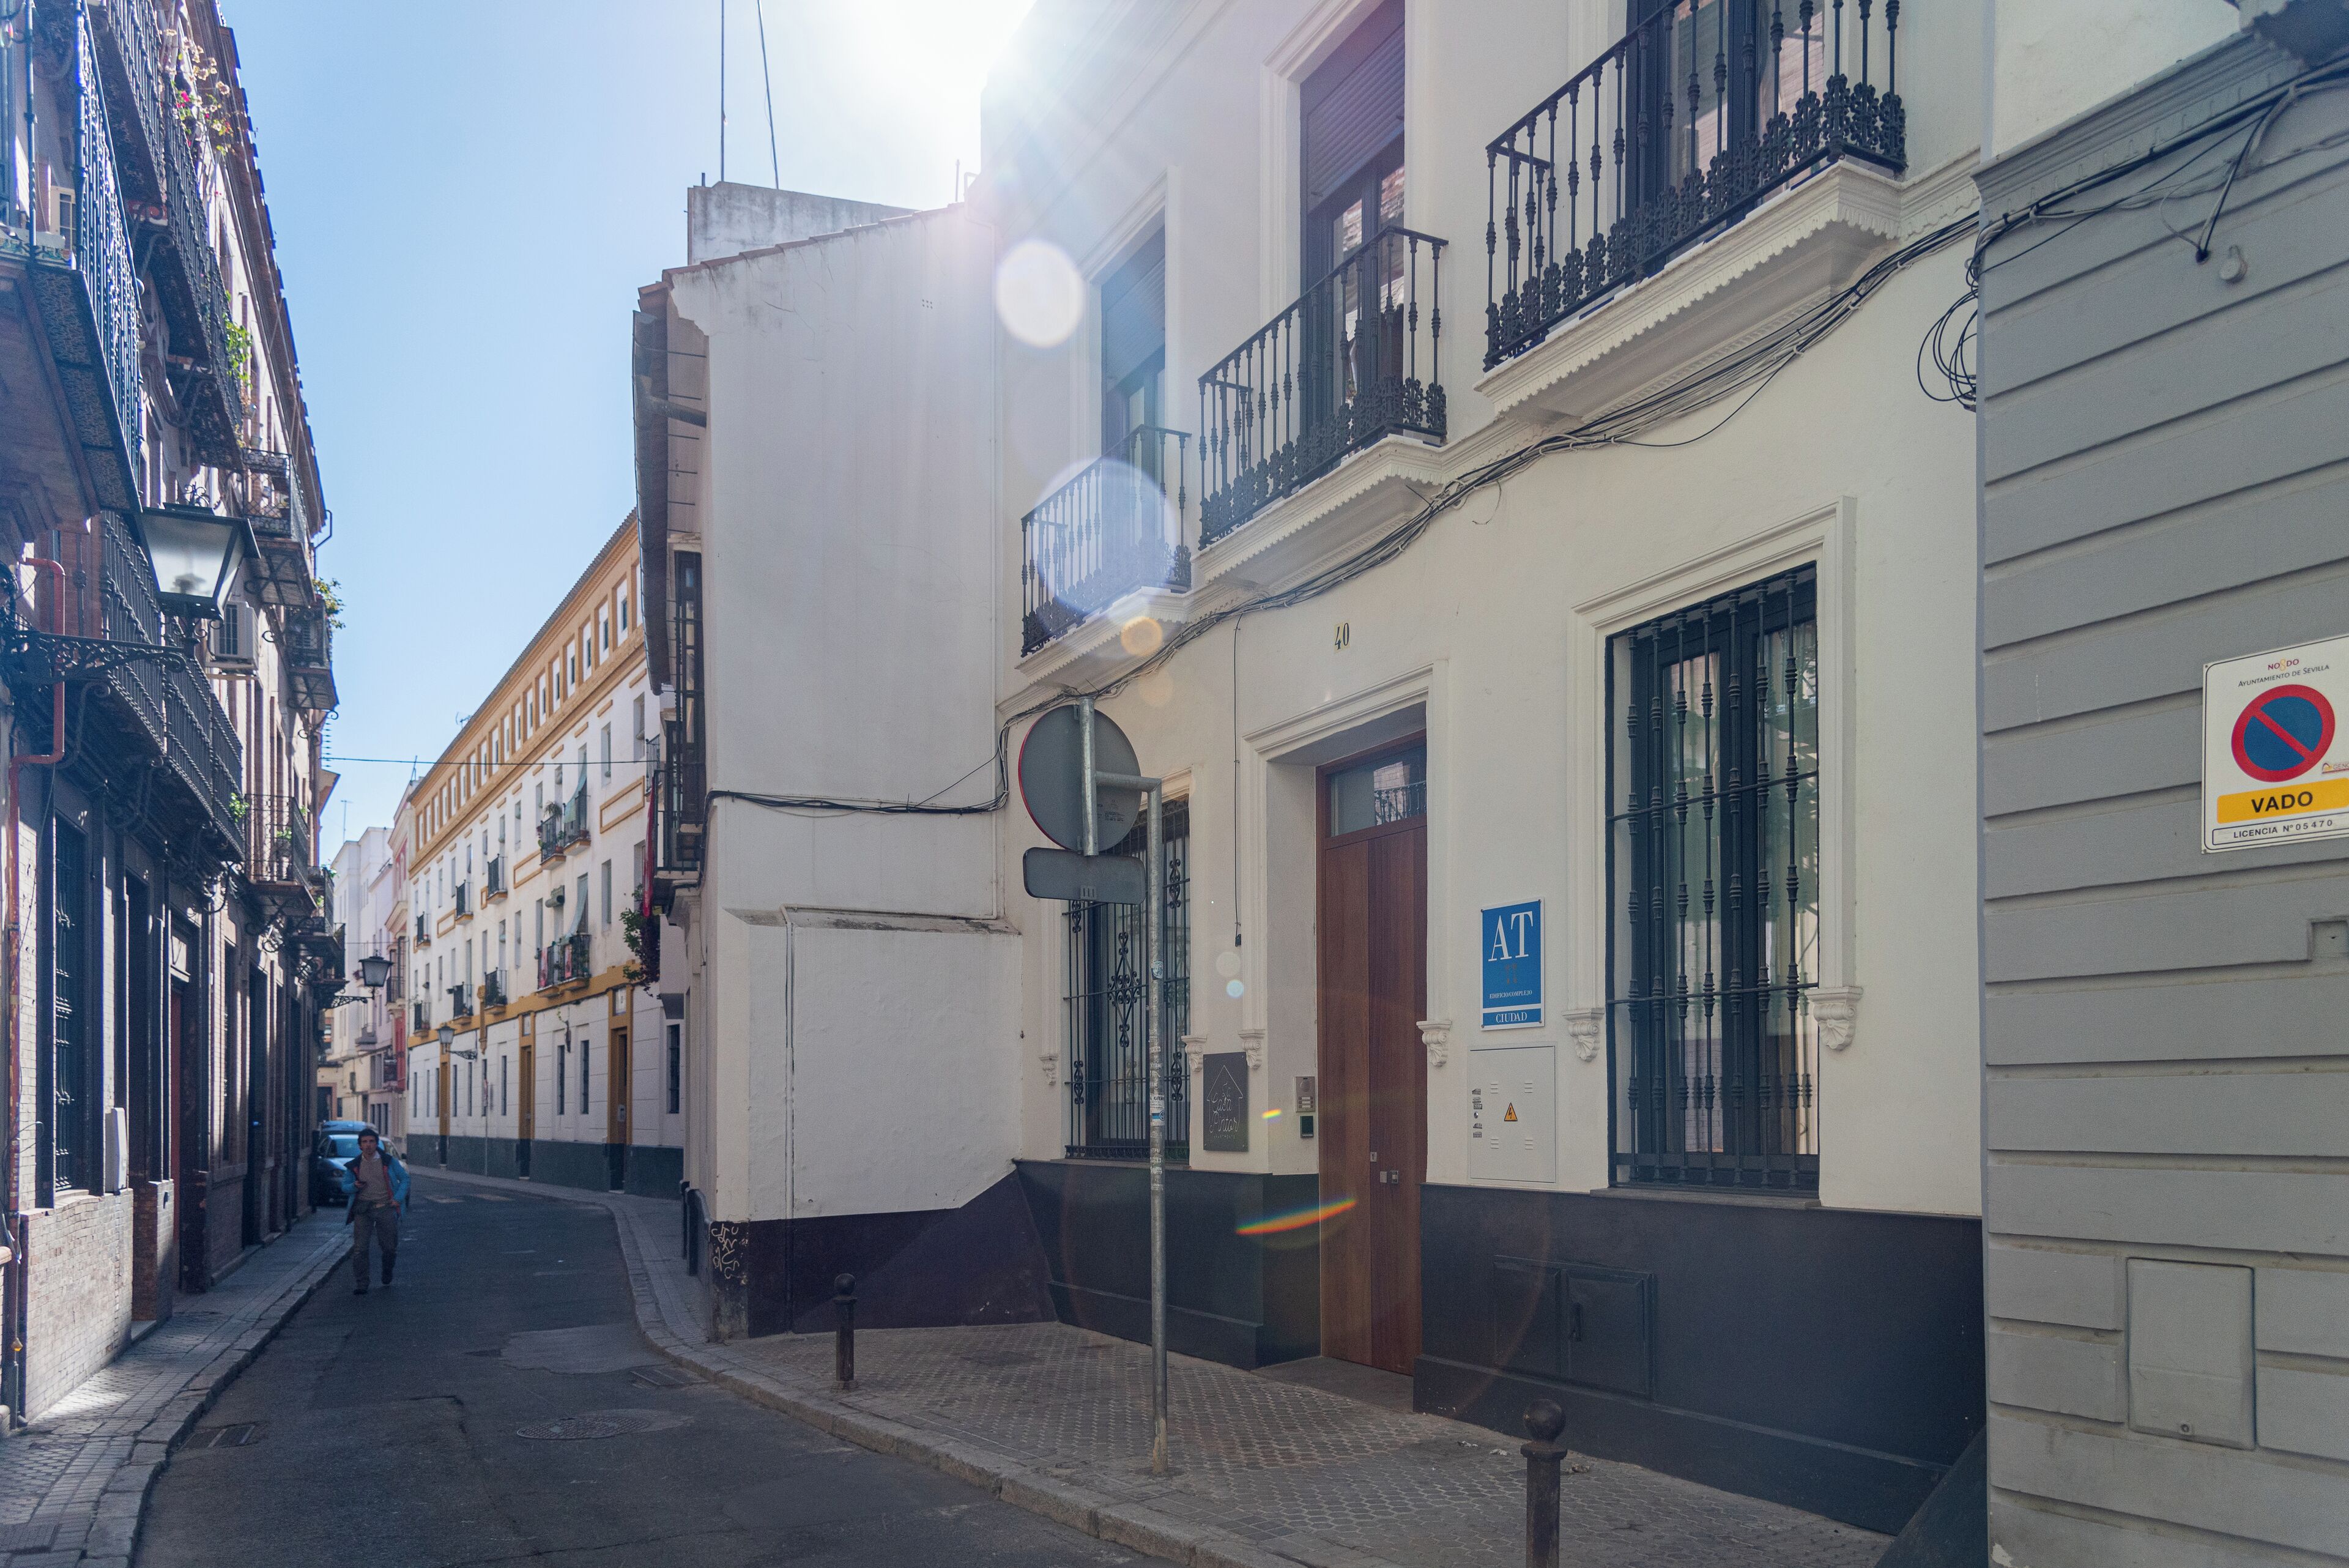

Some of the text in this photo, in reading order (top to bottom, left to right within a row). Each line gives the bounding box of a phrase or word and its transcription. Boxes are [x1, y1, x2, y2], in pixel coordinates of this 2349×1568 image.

[1335, 623, 1349, 650] 40
[2251, 791, 2313, 813] VADO
[2233, 827, 2277, 838] LICENCIA
[1488, 910, 1534, 962] AT
[1496, 1011, 1527, 1024] CIUDAD
